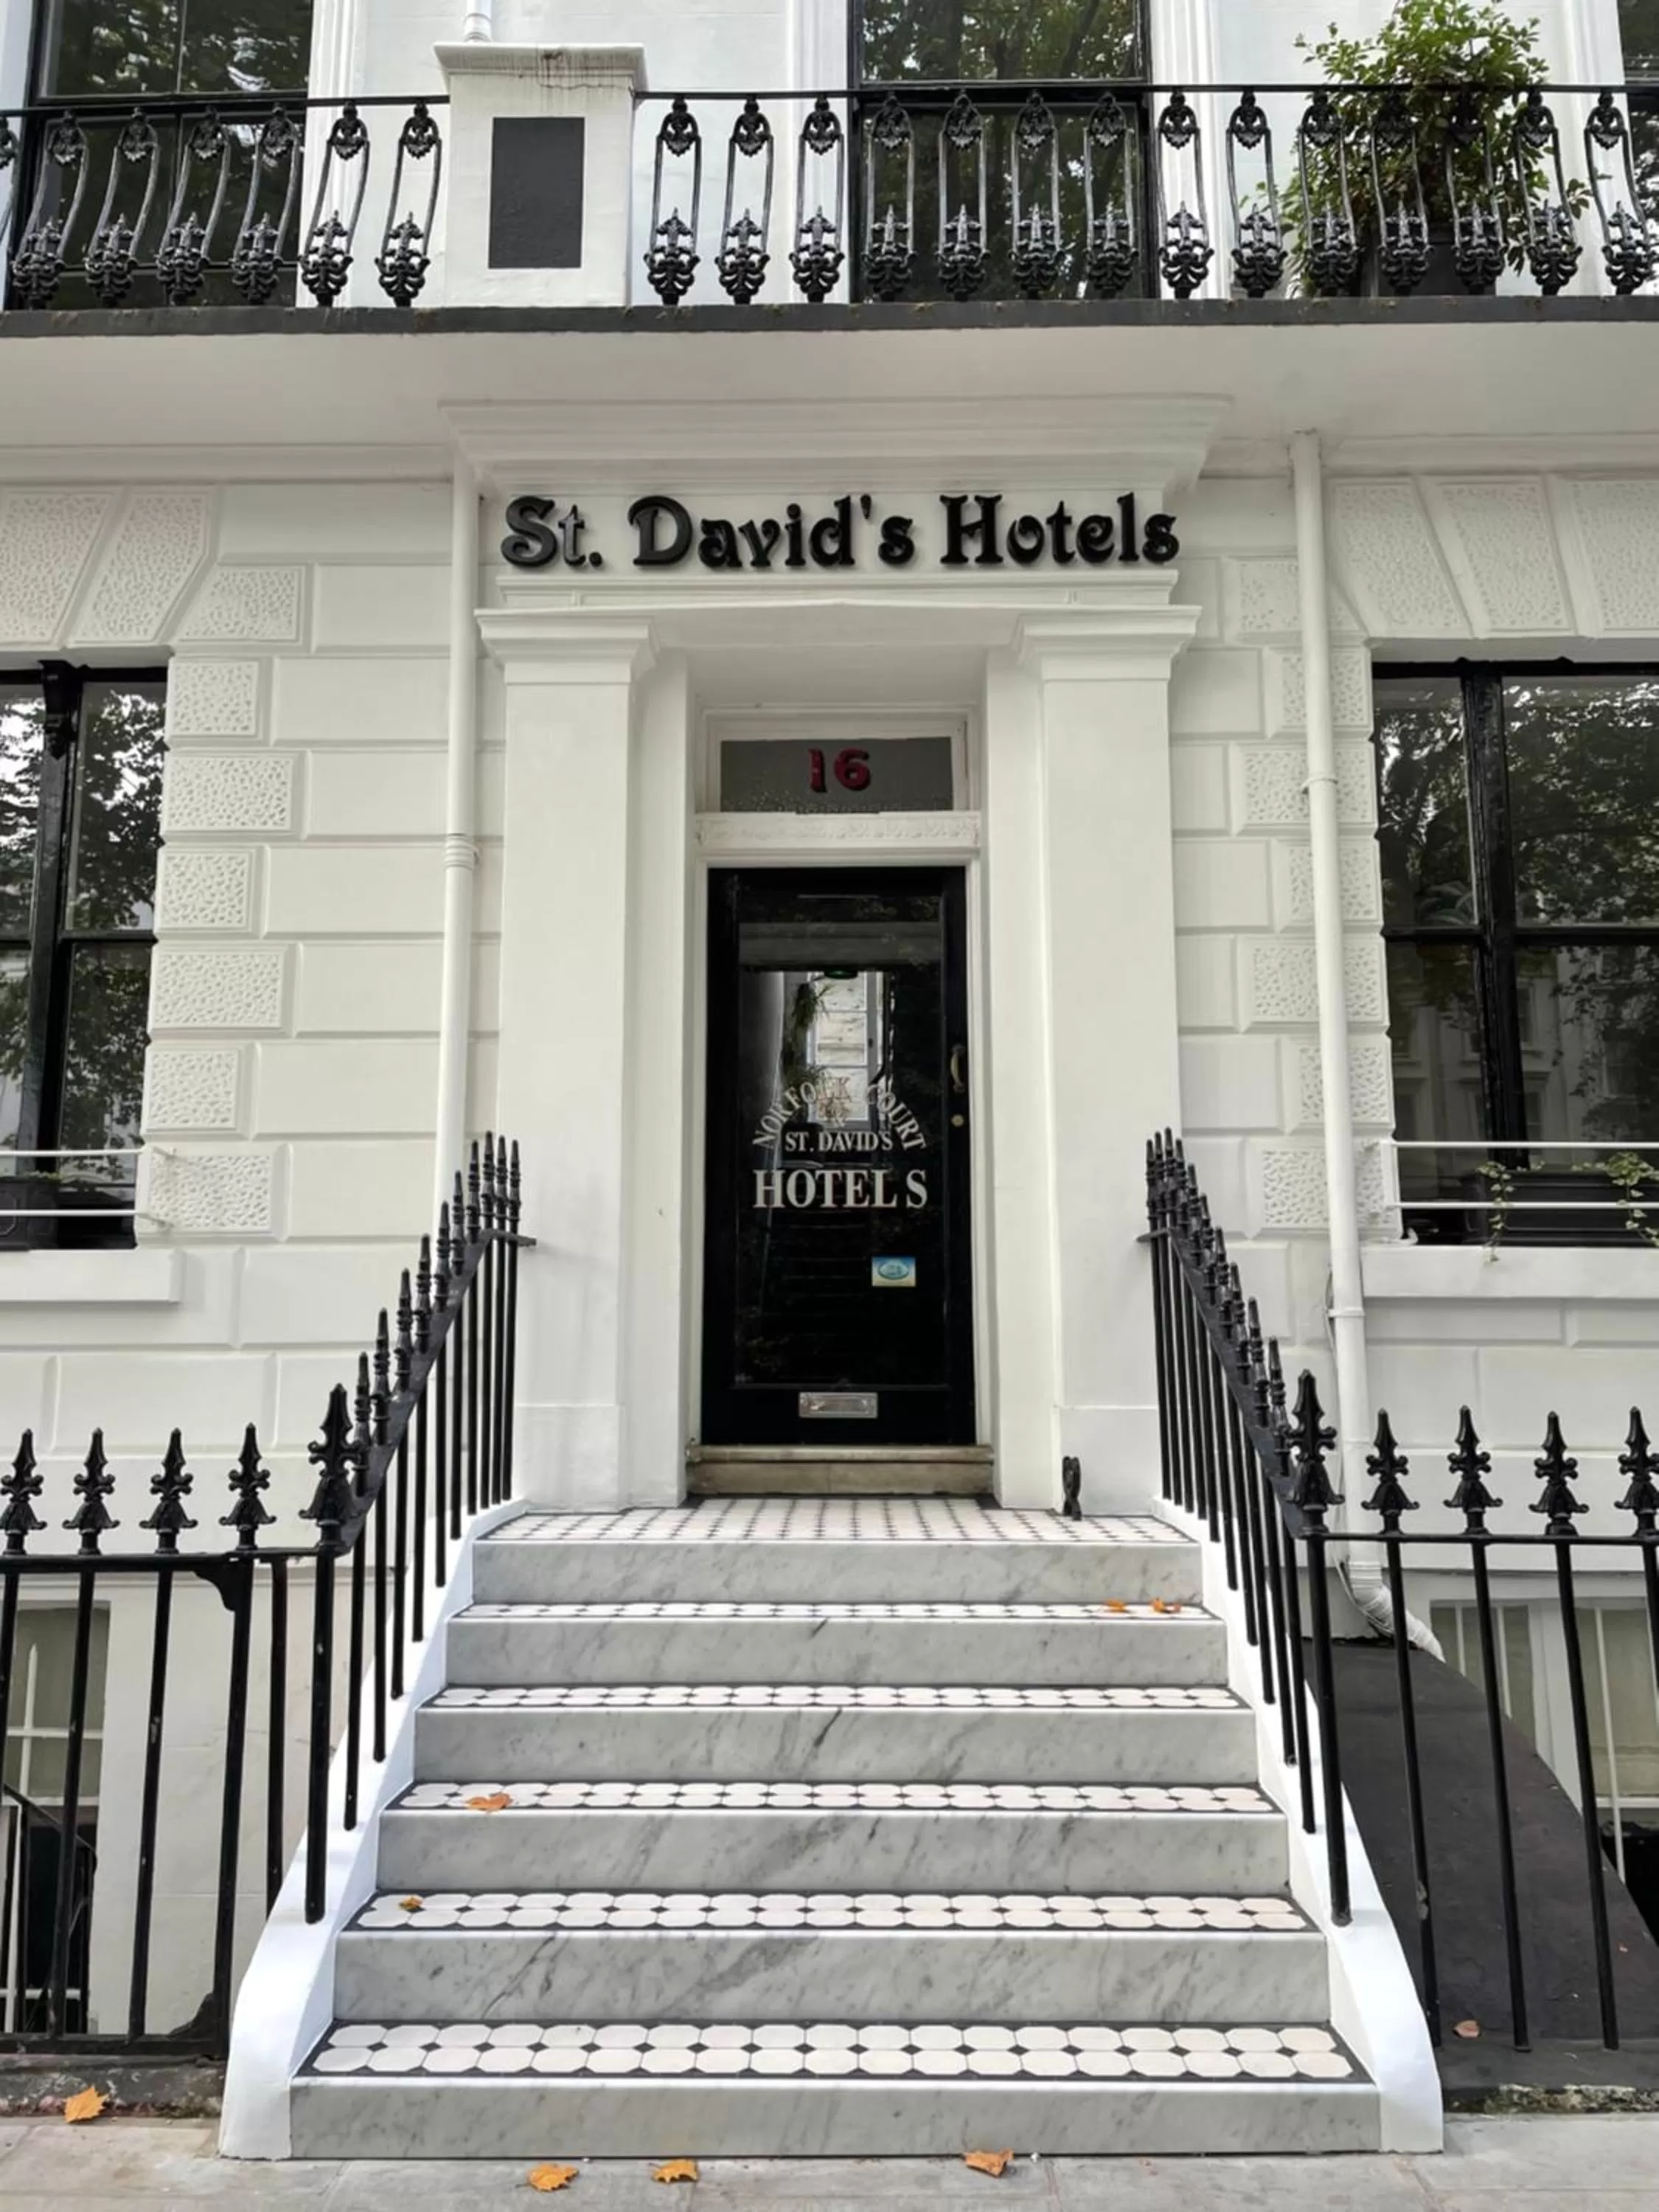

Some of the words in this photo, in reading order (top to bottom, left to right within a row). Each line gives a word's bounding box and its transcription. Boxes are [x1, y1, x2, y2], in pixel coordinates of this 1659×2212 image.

[501, 495, 603, 567] St.
[627, 495, 915, 567] David's
[940, 492, 1180, 565] Hotels
[809, 748, 871, 793] 16
[752, 1077, 852, 1148] NORFOK
[866, 1083, 927, 1150] COURT
[818, 1131, 894, 1152] DAVID'S
[752, 1169, 928, 1208] HOTELS
